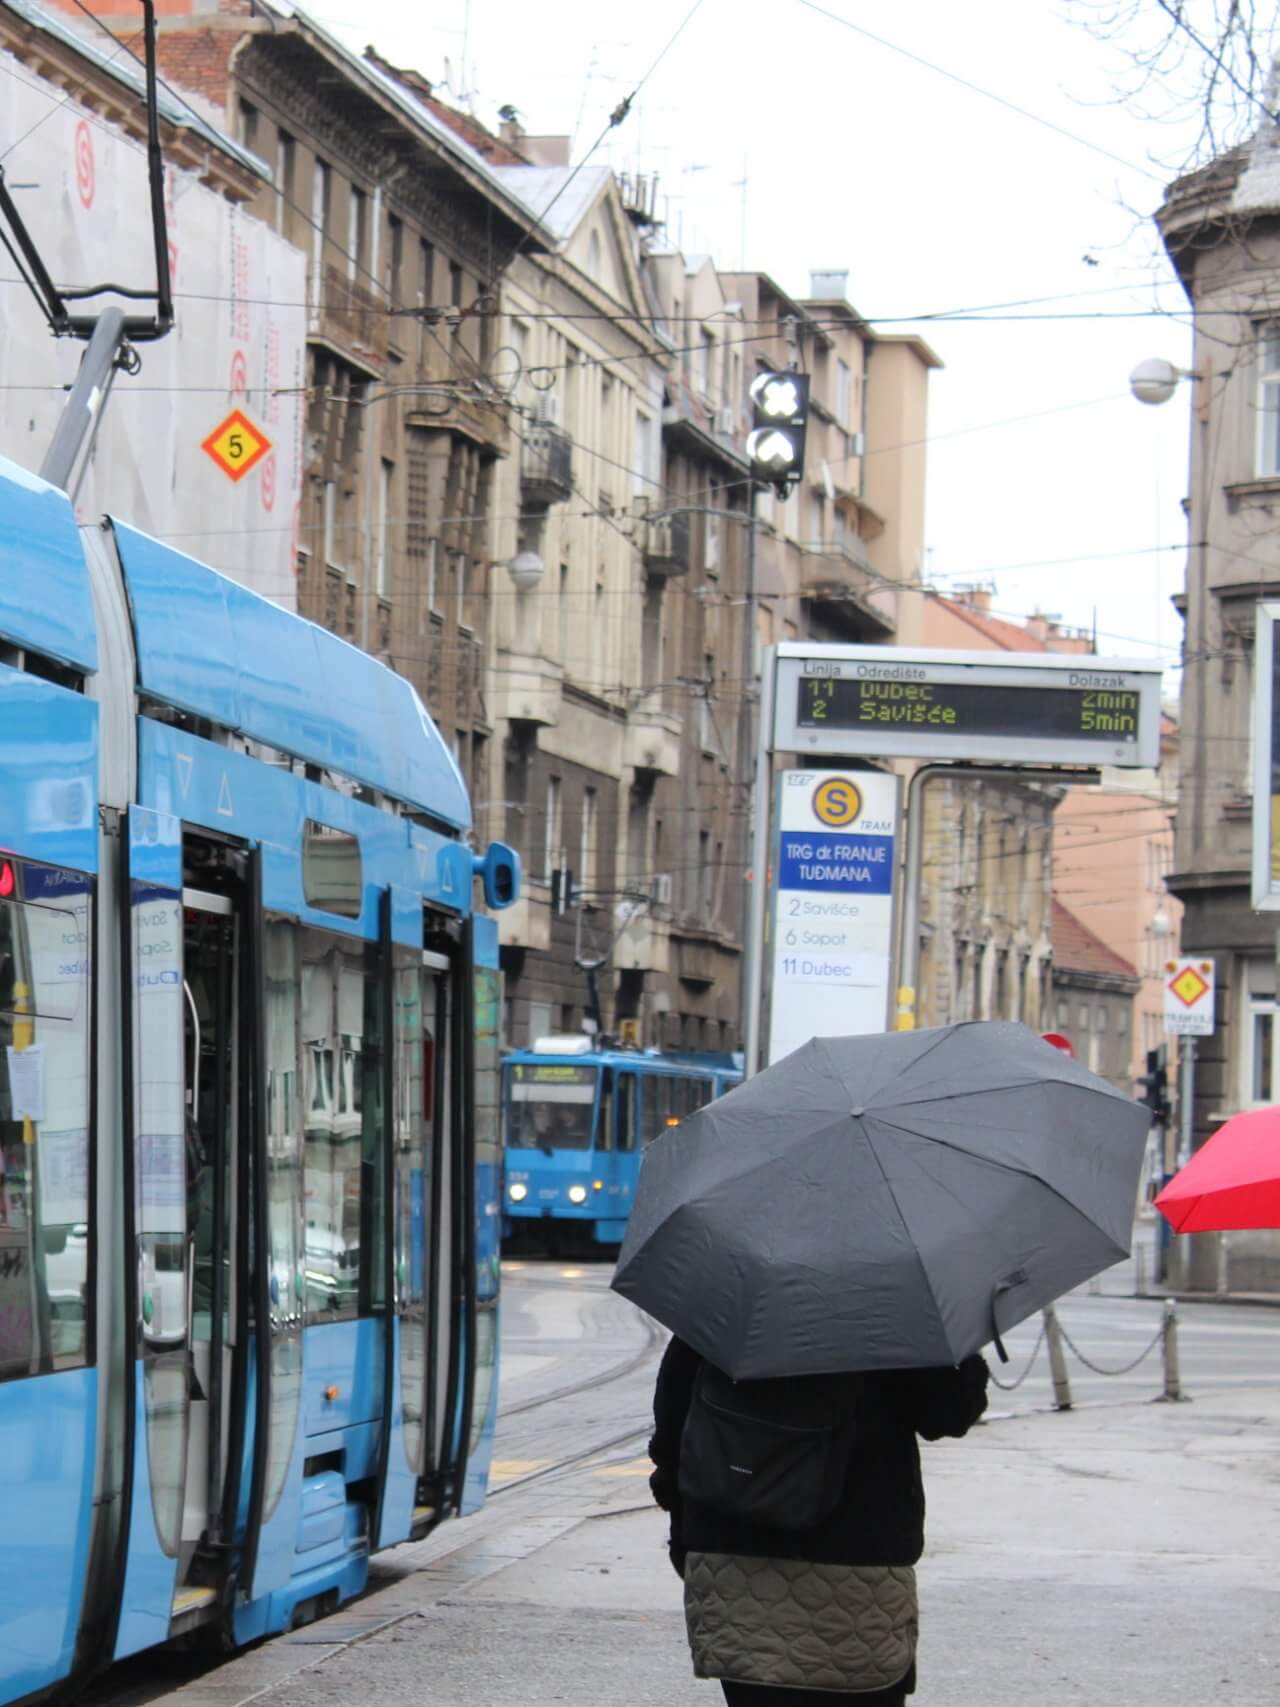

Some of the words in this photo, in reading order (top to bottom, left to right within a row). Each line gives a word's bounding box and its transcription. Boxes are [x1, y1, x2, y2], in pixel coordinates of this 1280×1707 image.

[229, 434, 243, 459] 5
[803, 663, 842, 679] Linija
[857, 664, 927, 680] Odredište
[1068, 673, 1126, 688] Dolazak
[808, 680, 834, 697] 11
[859, 680, 933, 700] Dubec
[1081, 690, 1136, 709] 2min
[811, 700, 827, 719] 2
[1081, 711, 1135, 731] 5min
[825, 788, 849, 817] S
[861, 820, 893, 831] TRAM
[786, 843, 813, 860] TRG
[834, 845, 887, 863] FRANJE
[799, 864, 873, 883] TUĐMANA
[789, 898, 801, 917] 2
[785, 928, 798, 946] 6
[801, 929, 848, 948] Sopot
[783, 957, 797, 975] 11
[802, 960, 853, 977] Dubec
